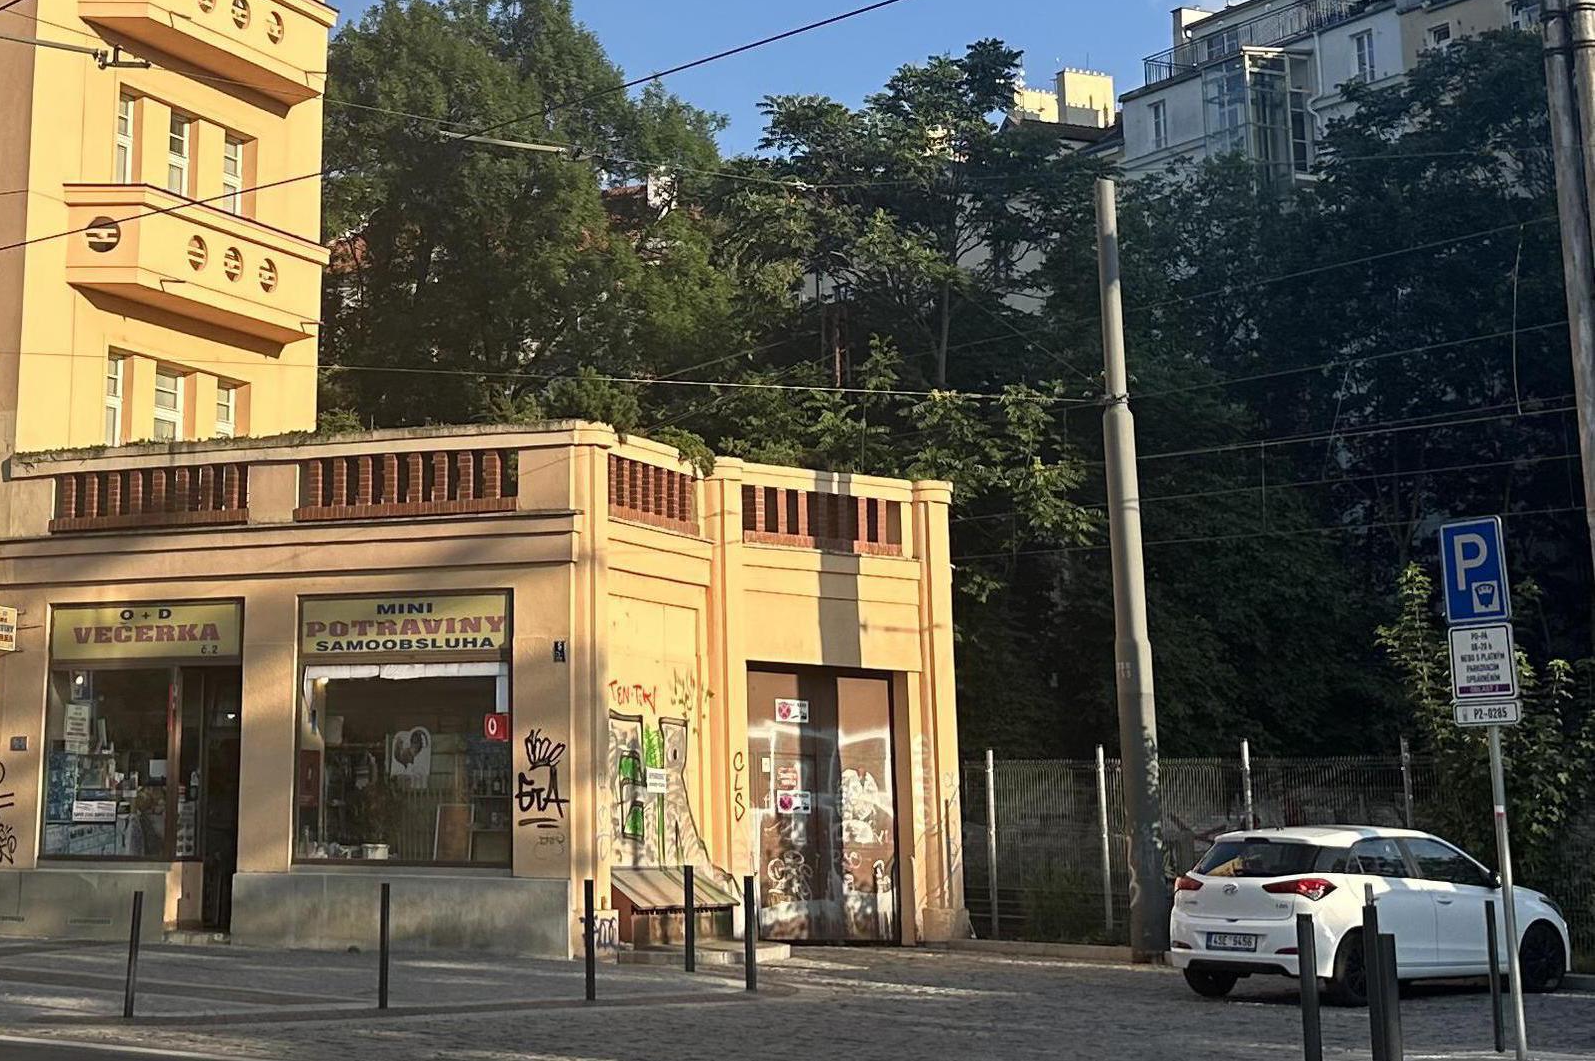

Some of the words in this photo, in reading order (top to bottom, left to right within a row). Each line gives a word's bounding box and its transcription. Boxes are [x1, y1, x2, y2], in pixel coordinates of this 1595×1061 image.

[1453, 533, 1487, 591] P
[121, 609, 134, 620] O
[158, 608, 172, 619] D
[376, 602, 434, 615] MINI
[73, 622, 221, 644] VEČERKA
[306, 615, 506, 638] POTRAVINY
[200, 645, 218, 655] č.2
[316, 637, 494, 652] SAMOOBSLUHA
